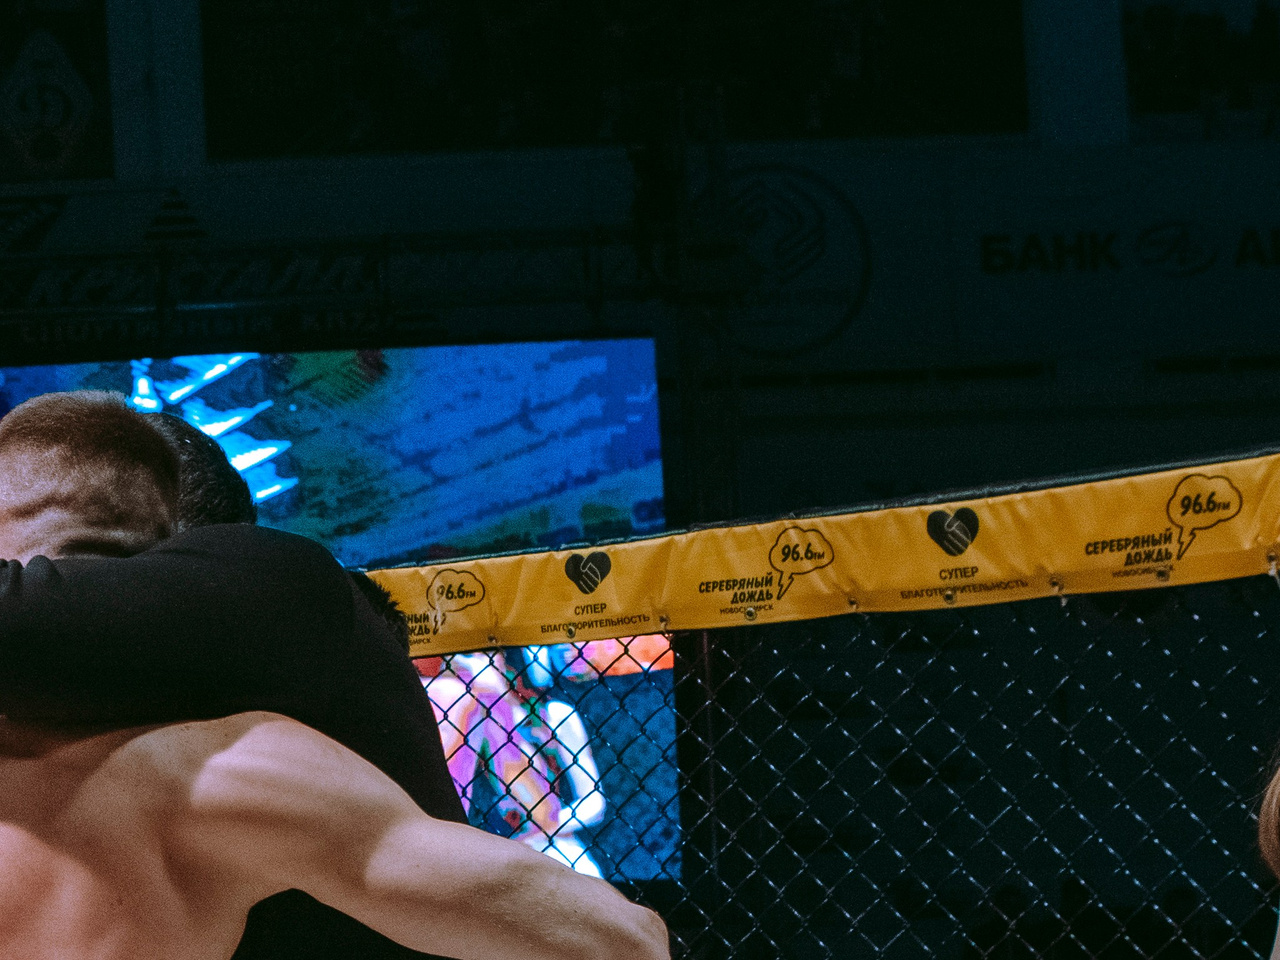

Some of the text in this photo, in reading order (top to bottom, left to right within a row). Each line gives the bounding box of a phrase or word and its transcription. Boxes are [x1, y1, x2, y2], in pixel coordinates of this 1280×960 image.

[980, 232, 1120, 274] БАНК
[1085, 528, 1172, 555] СЕРЕБРЯНЫЙ
[1124, 550, 1172, 566] ДОЖДЬ
[939, 566, 978, 580] СУПЕР
[699, 571, 773, 593] СЕРЕБРЯНЫЙ
[730, 589, 773, 604] ДОЖДЬ
[574, 603, 607, 616] СУПЕР
